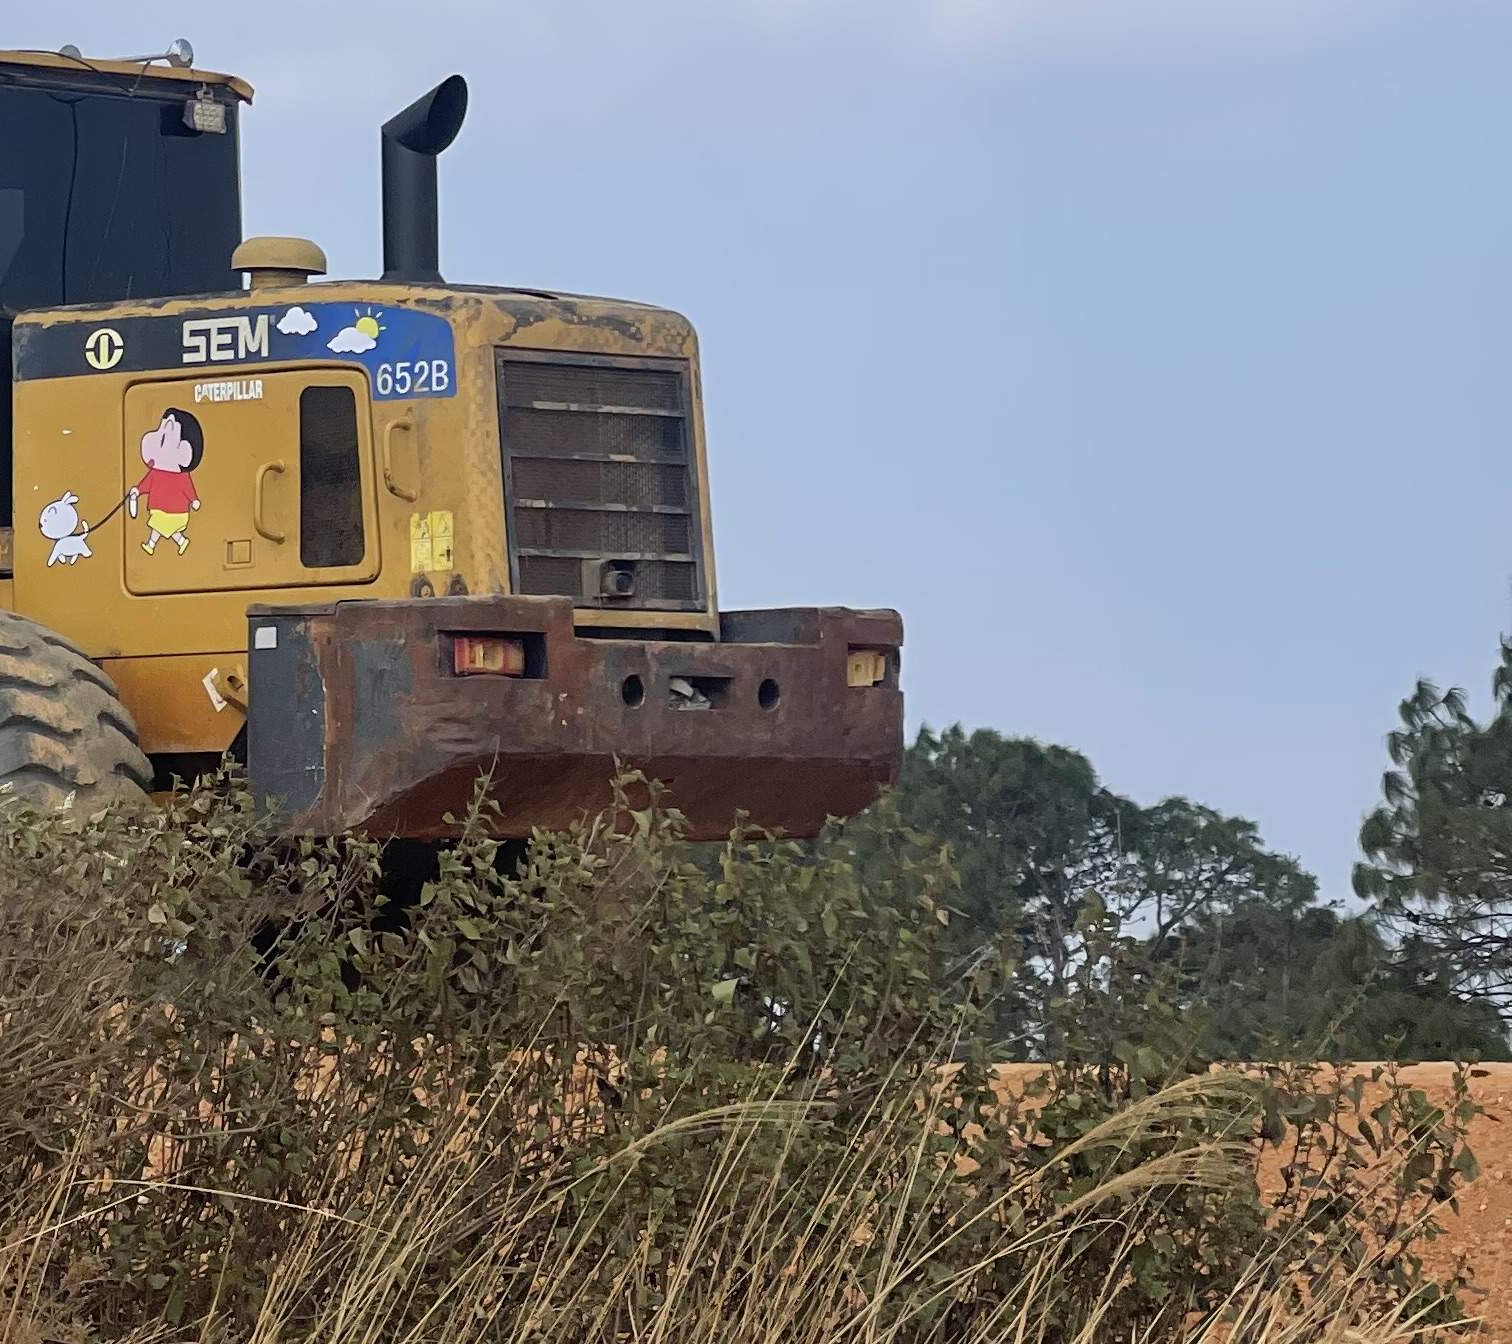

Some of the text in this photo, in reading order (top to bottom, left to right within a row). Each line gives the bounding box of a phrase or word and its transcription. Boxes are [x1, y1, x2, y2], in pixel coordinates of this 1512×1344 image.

[182, 314, 269, 363] SEM
[194, 380, 263, 403] CATERPILLAR
[376, 359, 449, 396] 652B
